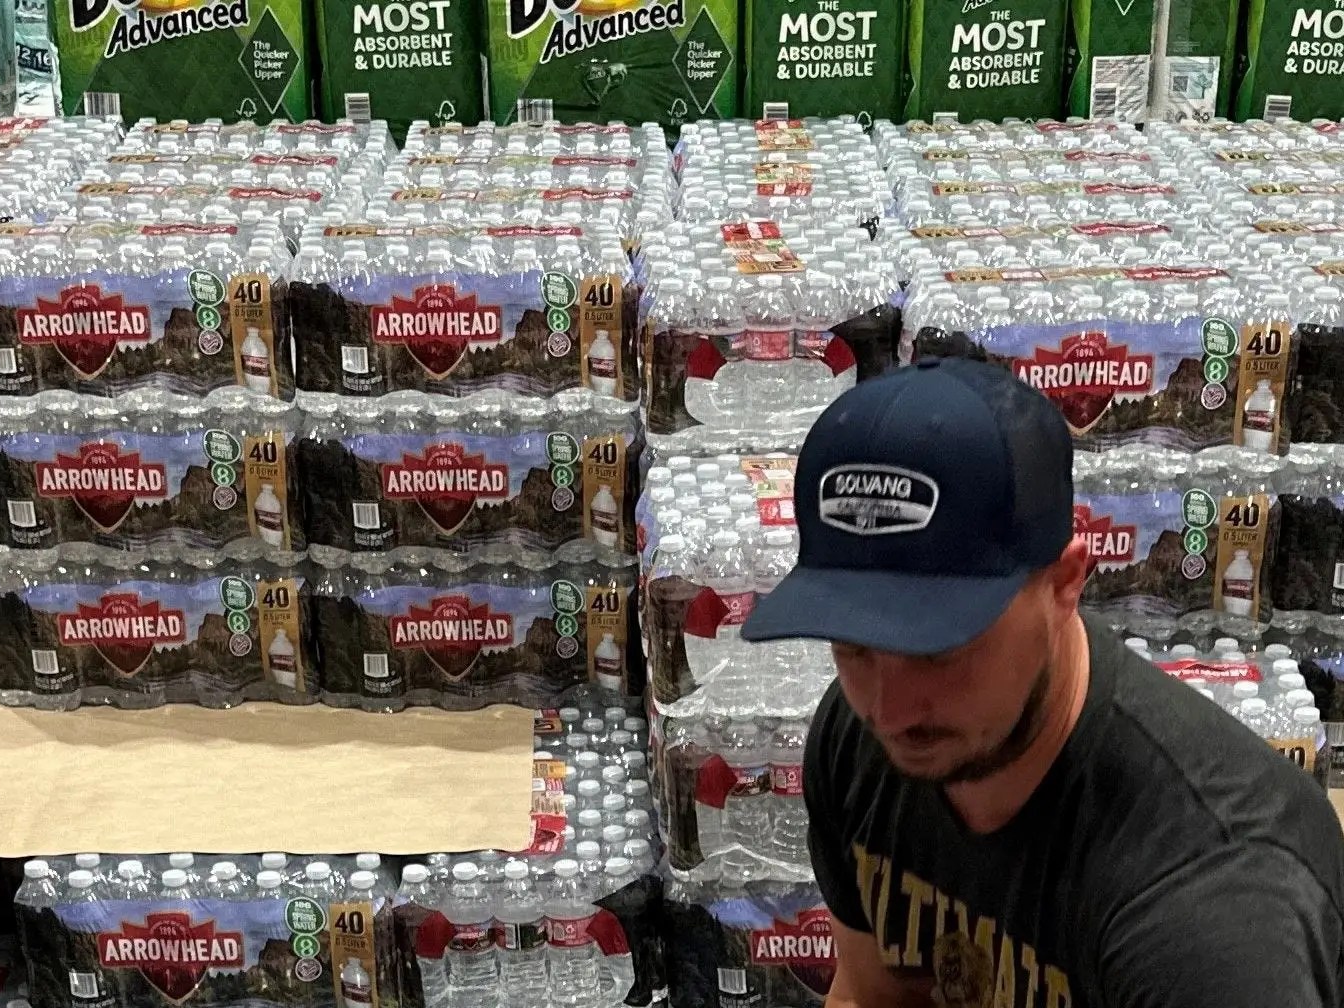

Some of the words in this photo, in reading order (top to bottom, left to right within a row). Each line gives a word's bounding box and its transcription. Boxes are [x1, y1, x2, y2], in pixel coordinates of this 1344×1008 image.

[818, 1, 839, 11] THE
[990, 10, 1010, 21] THE
[354, 2, 449, 33] MOST
[779, 11, 877, 43] MOST
[106, 3, 248, 57] Advanced
[540, 2, 686, 63] Advanced
[952, 19, 1045, 53] MOST
[254, 41, 270, 50] The
[354, 34, 453, 53] ABSORBENT
[688, 41, 705, 50] The
[777, 44, 877, 61] ABSORBENT
[254, 50, 289, 60] Quicker
[254, 60, 283, 70] Picker
[355, 56, 368, 70] &
[373, 51, 452, 69] DURABLE
[687, 50, 722, 60] Quicker
[687, 60, 715, 69] Picker
[949, 51, 1043, 72] ABSORBENT
[1284, 58, 1298, 74] &
[254, 69, 285, 80] Upper
[687, 69, 717, 80] Upper
[777, 64, 791, 79] &
[795, 61, 874, 79] DURABLE
[947, 74, 961, 90] &
[966, 68, 1041, 89] DURABLE
[233, 280, 262, 304] 40
[585, 284, 613, 308] 40
[23, 311, 146, 338] ARROWHEAD
[376, 311, 497, 336] ARROWHEAD
[1246, 330, 1281, 356] 40
[1017, 360, 1148, 389] ARROWHEAD
[248, 441, 277, 464] 40
[588, 443, 617, 465] 40
[42, 467, 161, 492] ARROWHEAD
[387, 468, 505, 493] ARROWHEAD
[1225, 503, 1260, 527] 40
[262, 587, 290, 608] 40
[591, 591, 620, 613] 40
[64, 616, 181, 640] ARROWHEAD
[395, 618, 508, 643] ARROWHEAD
[334, 911, 364, 936] 40
[104, 937, 239, 963] ARROWHEAD
[756, 935, 838, 959] ARROW
